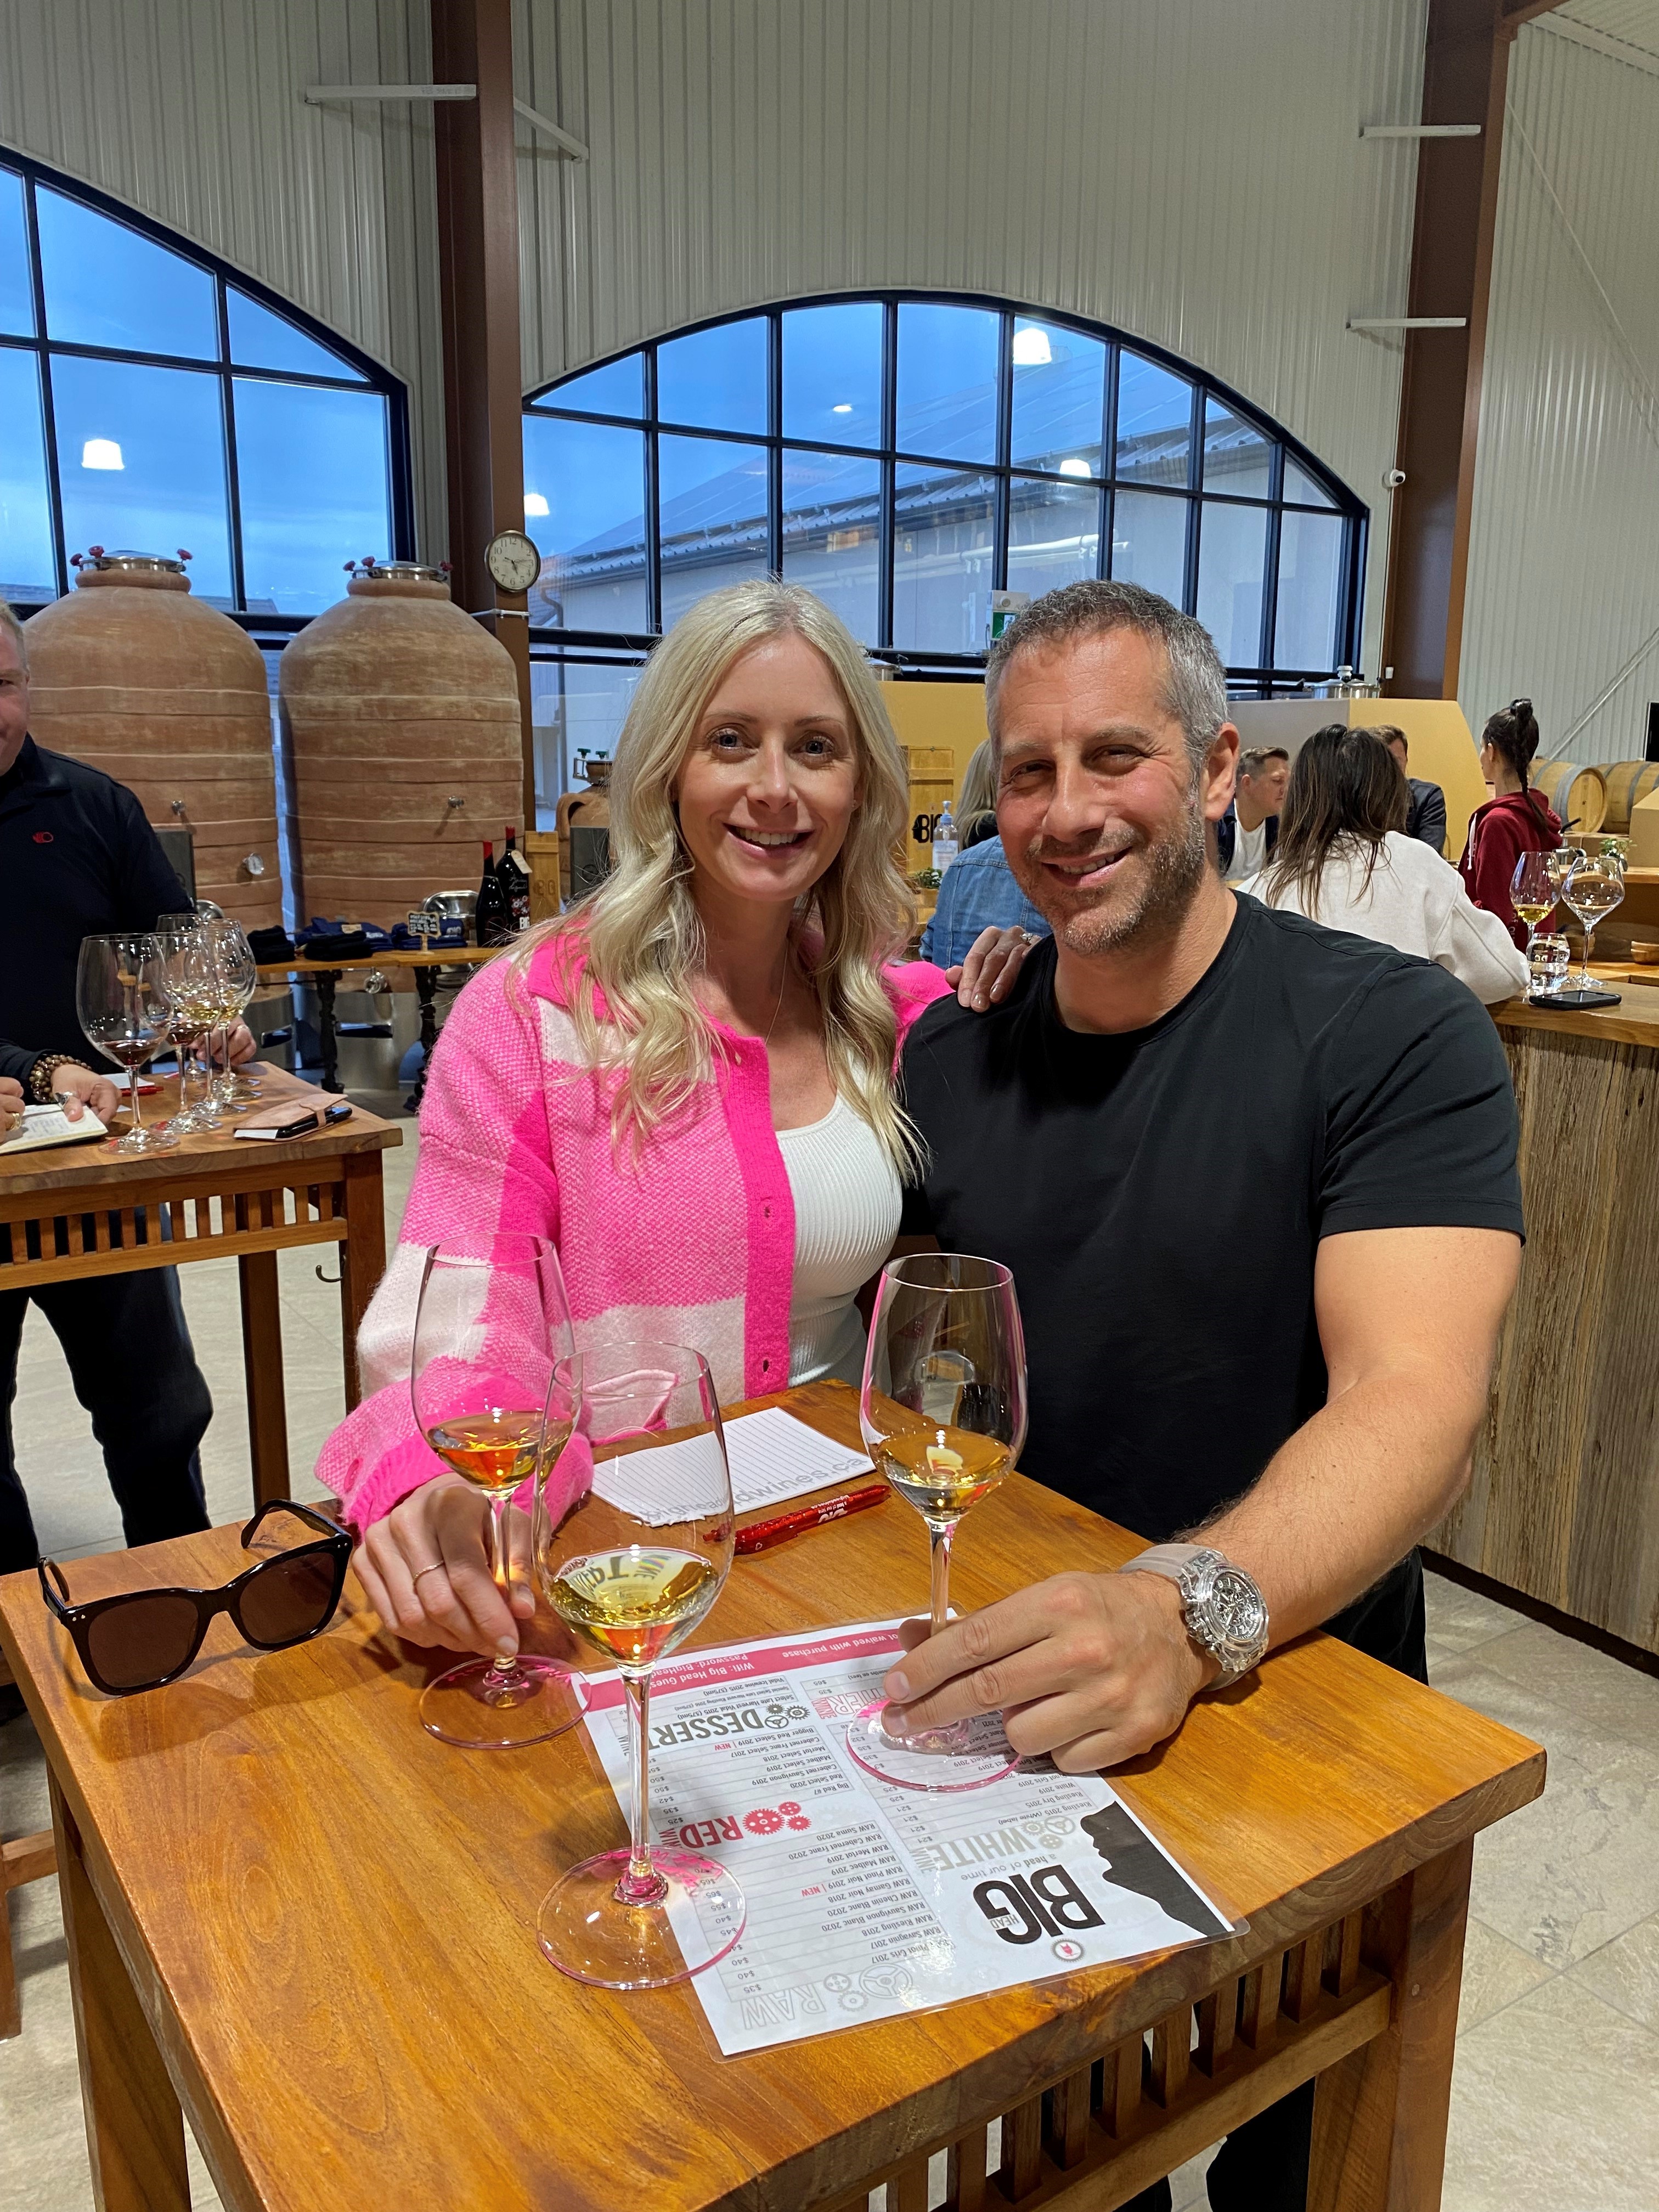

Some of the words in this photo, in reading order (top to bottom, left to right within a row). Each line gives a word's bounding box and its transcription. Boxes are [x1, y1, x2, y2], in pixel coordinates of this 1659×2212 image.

[501, 539, 507, 548] 11
[490, 556, 496, 564] 9
[494, 566, 499, 574] 8
[501, 574, 506, 583] 7
[520, 575, 524, 584] 5
[851, 1634, 887, 1646] waived
[828, 1641, 852, 1651] with
[781, 1645, 828, 1660] purchase
[694, 1653, 748, 1669] Password:
[707, 1665, 727, 1676] Big
[727, 1662, 754, 1673] Wifi:
[678, 1671, 707, 1682] Head
[743, 1680, 768, 1689] Icewine
[702, 1686, 728, 1696] (375ml)
[774, 1694, 794, 1702] Select
[735, 1700, 760, 1709] Harvest
[809, 1697, 837, 1720] WINE
[676, 1710, 703, 1720] (375ml)
[790, 1726, 814, 1736] Bigger
[754, 1734, 776, 1743] Select
[788, 1736, 820, 1747] Cabernet
[712, 1742, 731, 1751] NEW
[746, 1746, 769, 1754] Select
[769, 1742, 788, 1750] Franc
[802, 1745, 826, 1754] Merlot
[779, 1750, 802, 1758] Select
[805, 1754, 831, 1764] Malbec
[782, 1759, 805, 1768] Select
[804, 1763, 837, 1774] Cabernet
[768, 1769, 805, 1782] Sauvignon
[806, 1776, 829, 1785] Select
[789, 1780, 807, 1788] 2020
[836, 1781, 849, 1790] Big
[1054, 1782, 1075, 1790] White
[657, 1796, 674, 1804] $42
[1054, 1791, 1083, 1801] Riesling
[662, 1806, 679, 1814] $35
[1060, 1800, 1092, 1812] Riesling
[667, 1816, 684, 1825] $25
[835, 1826, 857, 1836] Suma
[856, 1823, 876, 1831] RAW
[675, 1815, 744, 1851] RED
[815, 1832, 836, 1841] 2020
[864, 1833, 882, 1842] RAW
[828, 1837, 865, 1850] Cabernet
[870, 1844, 889, 1853] RAW
[924, 1825, 1036, 1871] WHITE
[787, 1850, 808, 1859] 2020
[807, 1846, 829, 1855] Franc
[844, 1848, 871, 1859] Merlot
[825, 1854, 845, 1863] 2019
[877, 1855, 896, 1864] RAW
[1022, 1855, 1048, 1867] head
[848, 1859, 878, 1871] Malbec
[986, 1865, 1007, 1874] our
[1008, 1861, 1023, 1870] of
[829, 1866, 849, 1875] 2019
[862, 1870, 884, 1880] Pinot
[884, 1866, 903, 1875] RAW
[845, 1875, 864, 1884] Noir
[959, 1870, 988, 1882] time
[826, 1880, 846, 1889] 2019
[863, 1881, 892, 1894] Gamay
[891, 1878, 911, 1887] RAW
[799, 1886, 821, 1897] NEW
[847, 1888, 865, 1898] Noir
[898, 1889, 918, 1899] RAW
[826, 1893, 847, 1903] 2018
[870, 1894, 899, 1906] Chenin
[709, 1902, 727, 1911] $55
[847, 1901, 871, 1912] Blanc
[906, 1901, 926, 1911] RAW
[973, 1865, 1107, 1945] BIG
[826, 1906, 848, 1916] 2020
[864, 1905, 907, 1922] Sauvignon
[714, 1915, 732, 1924] $40
[841, 1916, 866, 1927] Blanc
[913, 1914, 933, 1923] RAW
[988, 1914, 1020, 1929] HEAD
[820, 1921, 842, 1932] 2020
[879, 1917, 914, 1932] Riesling
[860, 1926, 881, 1937] 2018
[921, 1926, 941, 1936] RAW
[886, 1929, 922, 1945] Savagnin
[868, 1939, 888, 1949] 2017
[730, 1956, 749, 1966] $40
[868, 1953, 890, 1964] 2017
[736, 1970, 755, 1980] $40
[742, 1983, 762, 1994] $35
[738, 1983, 825, 2030] RAW
